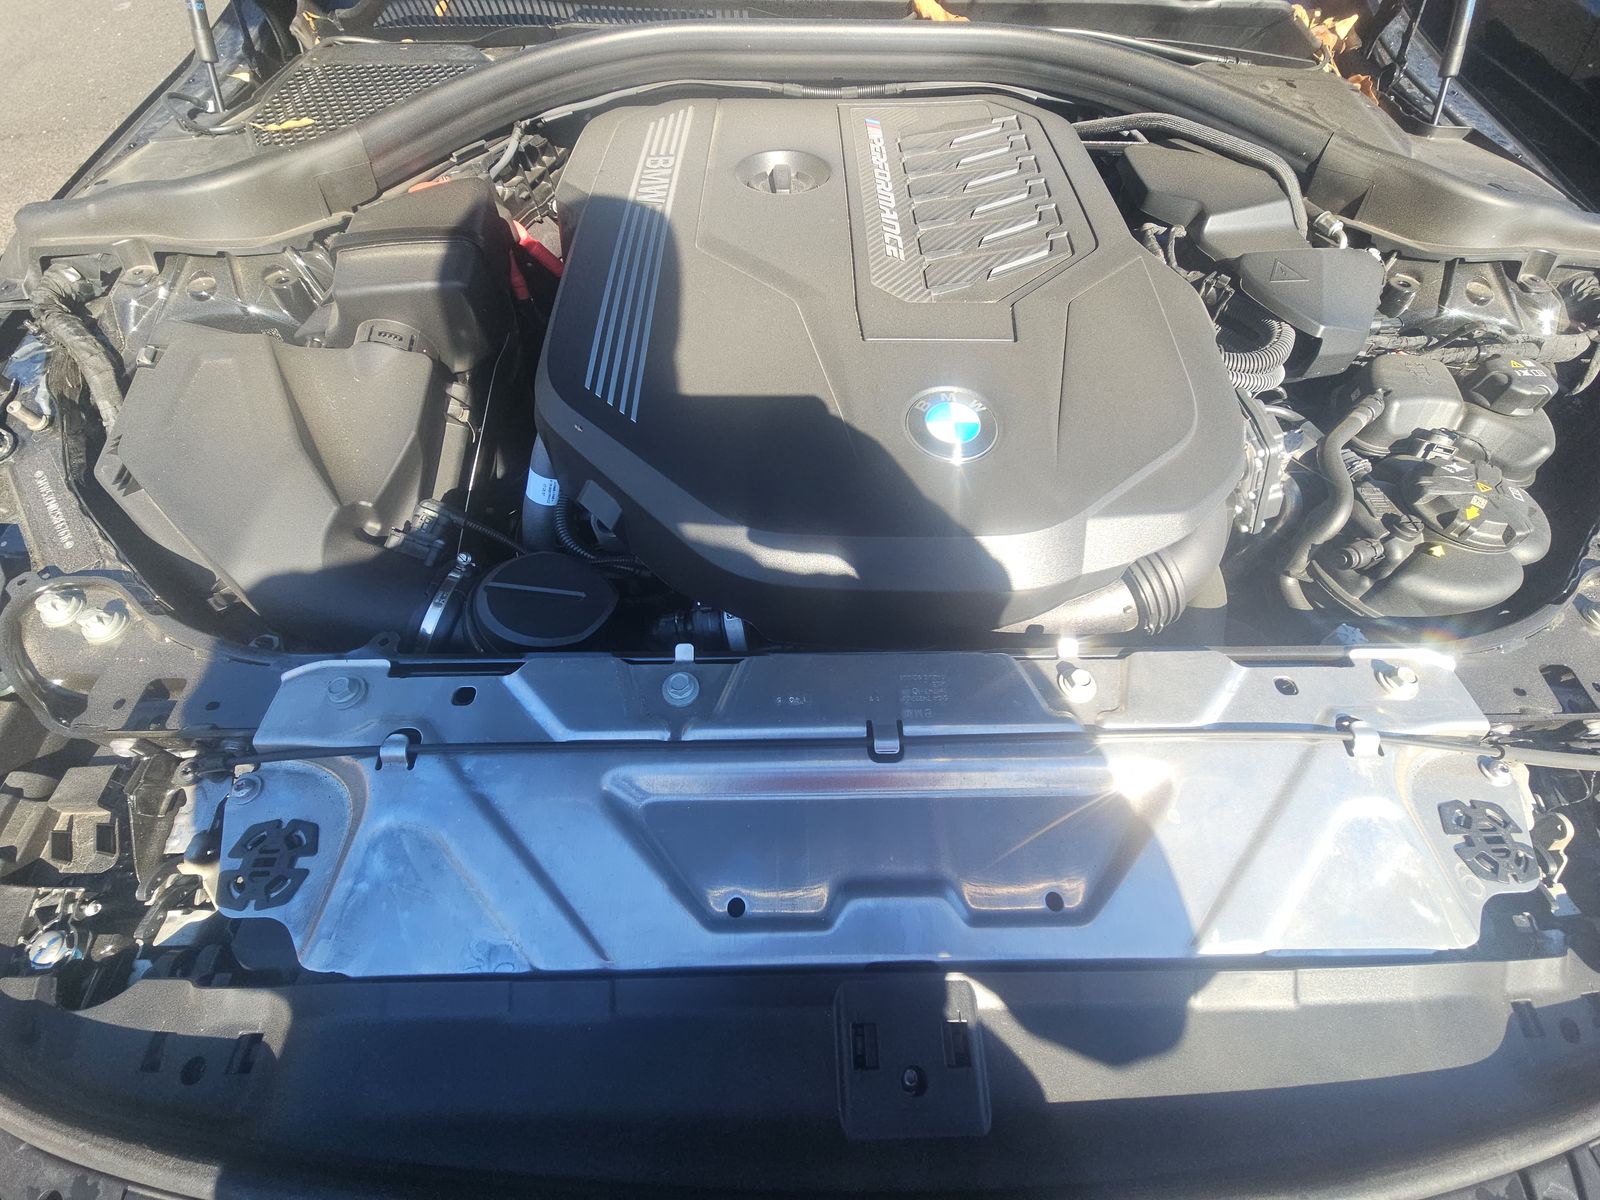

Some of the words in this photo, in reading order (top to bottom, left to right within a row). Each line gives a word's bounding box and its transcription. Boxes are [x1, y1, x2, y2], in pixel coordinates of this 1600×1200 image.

[635, 155, 676, 204] BMW
[867, 131, 906, 263] PERFORMANCE
[914, 392, 988, 412] BMW
